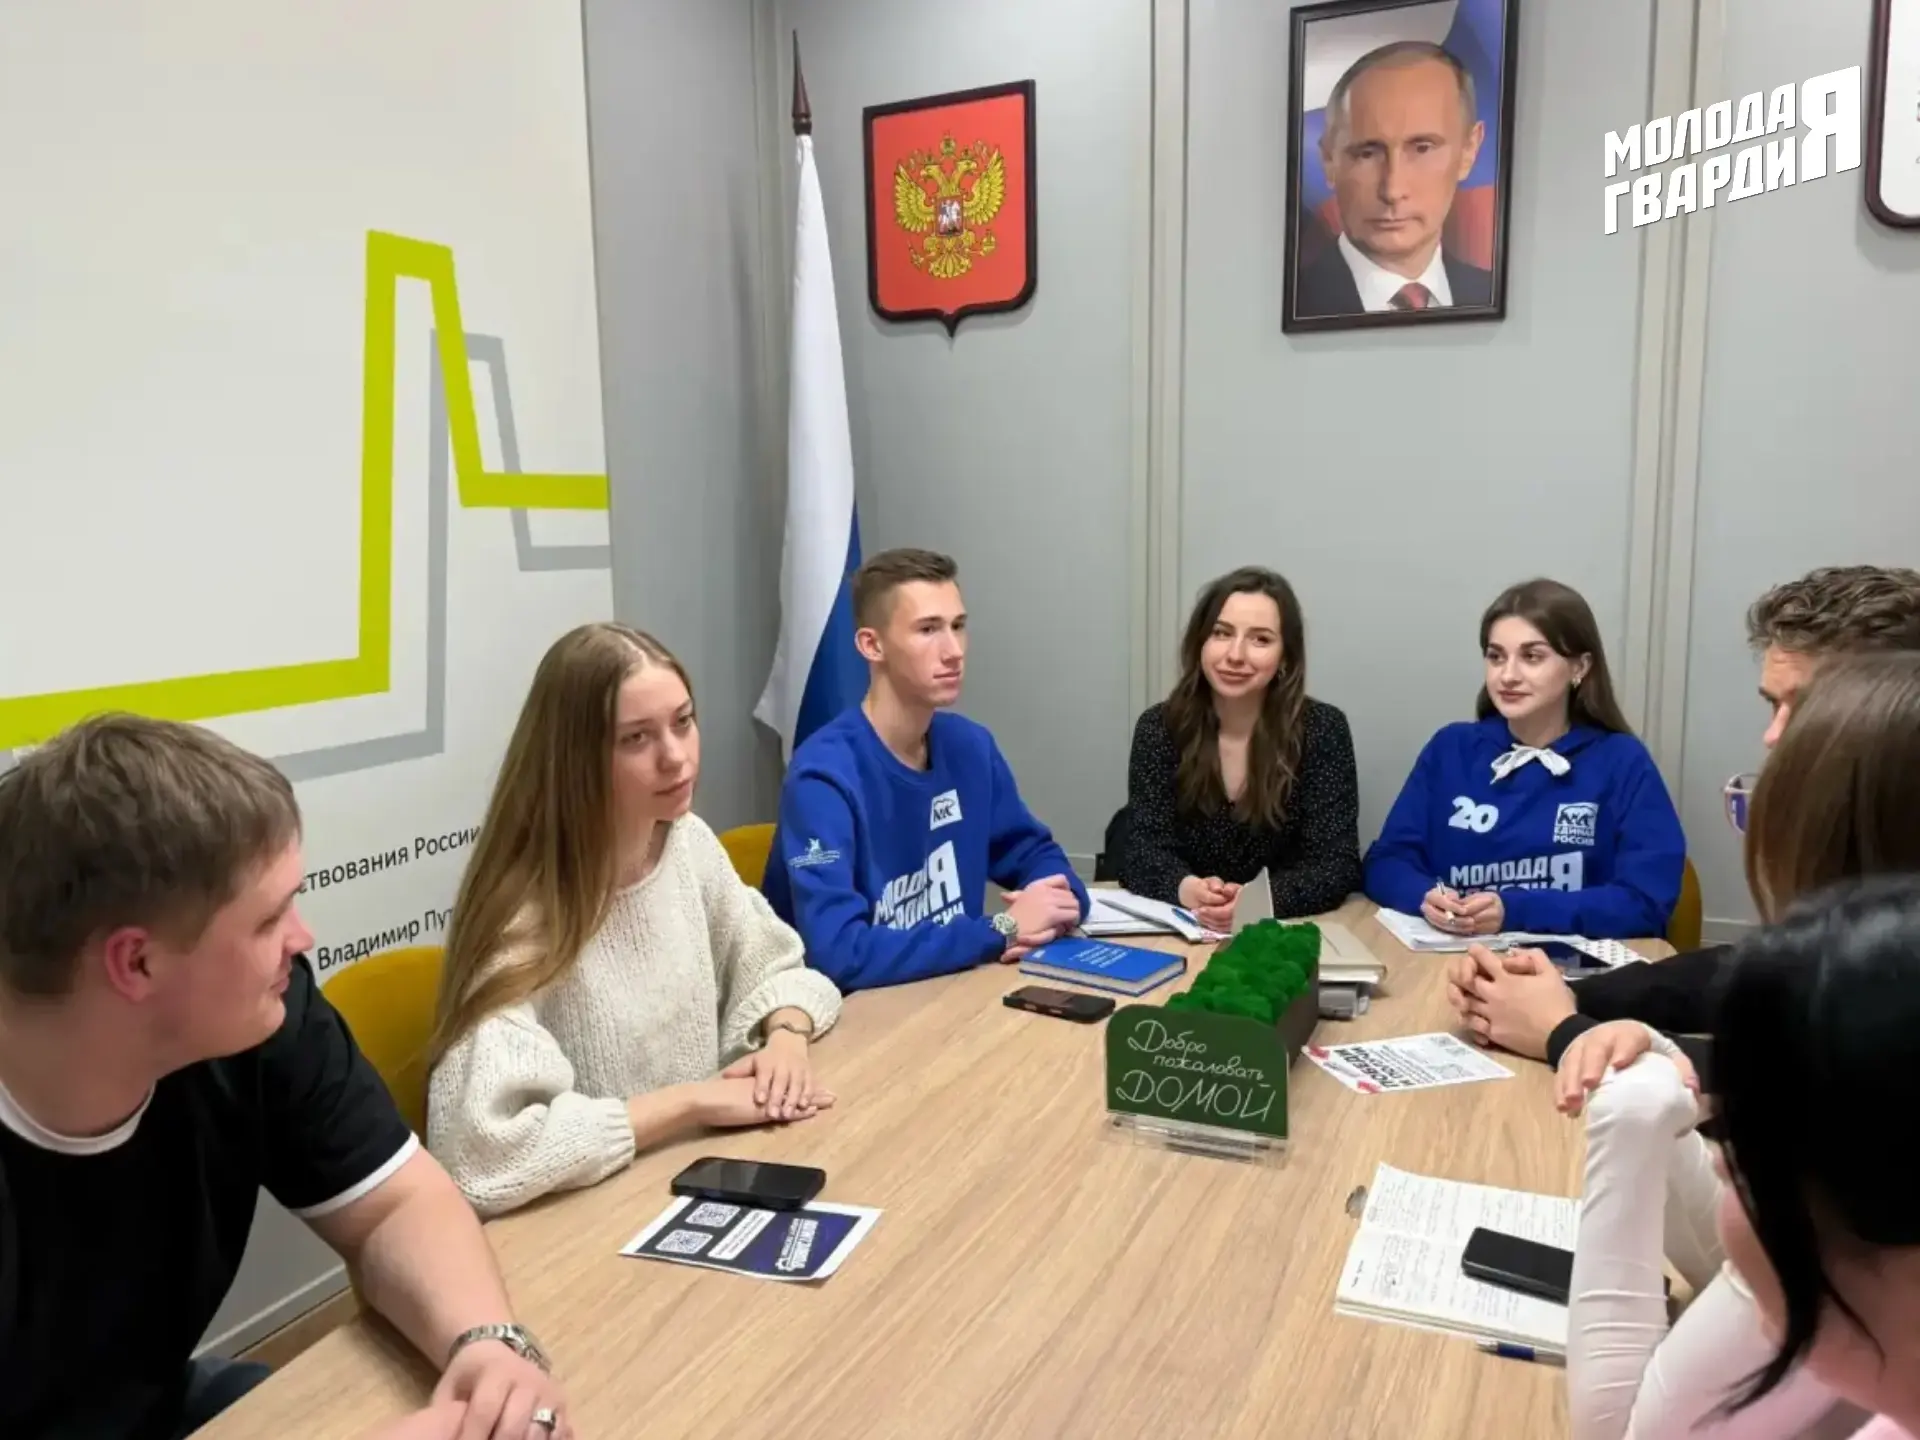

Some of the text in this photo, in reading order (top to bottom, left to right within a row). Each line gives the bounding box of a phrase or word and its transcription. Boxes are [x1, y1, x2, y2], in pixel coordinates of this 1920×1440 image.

[1448, 796, 1499, 833] 20
[1450, 851, 1583, 893] МОЛОДАЯ
[317, 920, 419, 970] Владимир
[1127, 1019, 1207, 1060] Добро
[1153, 1055, 1264, 1080] пожаловать
[1115, 1069, 1276, 1122] ДОМОЙ
